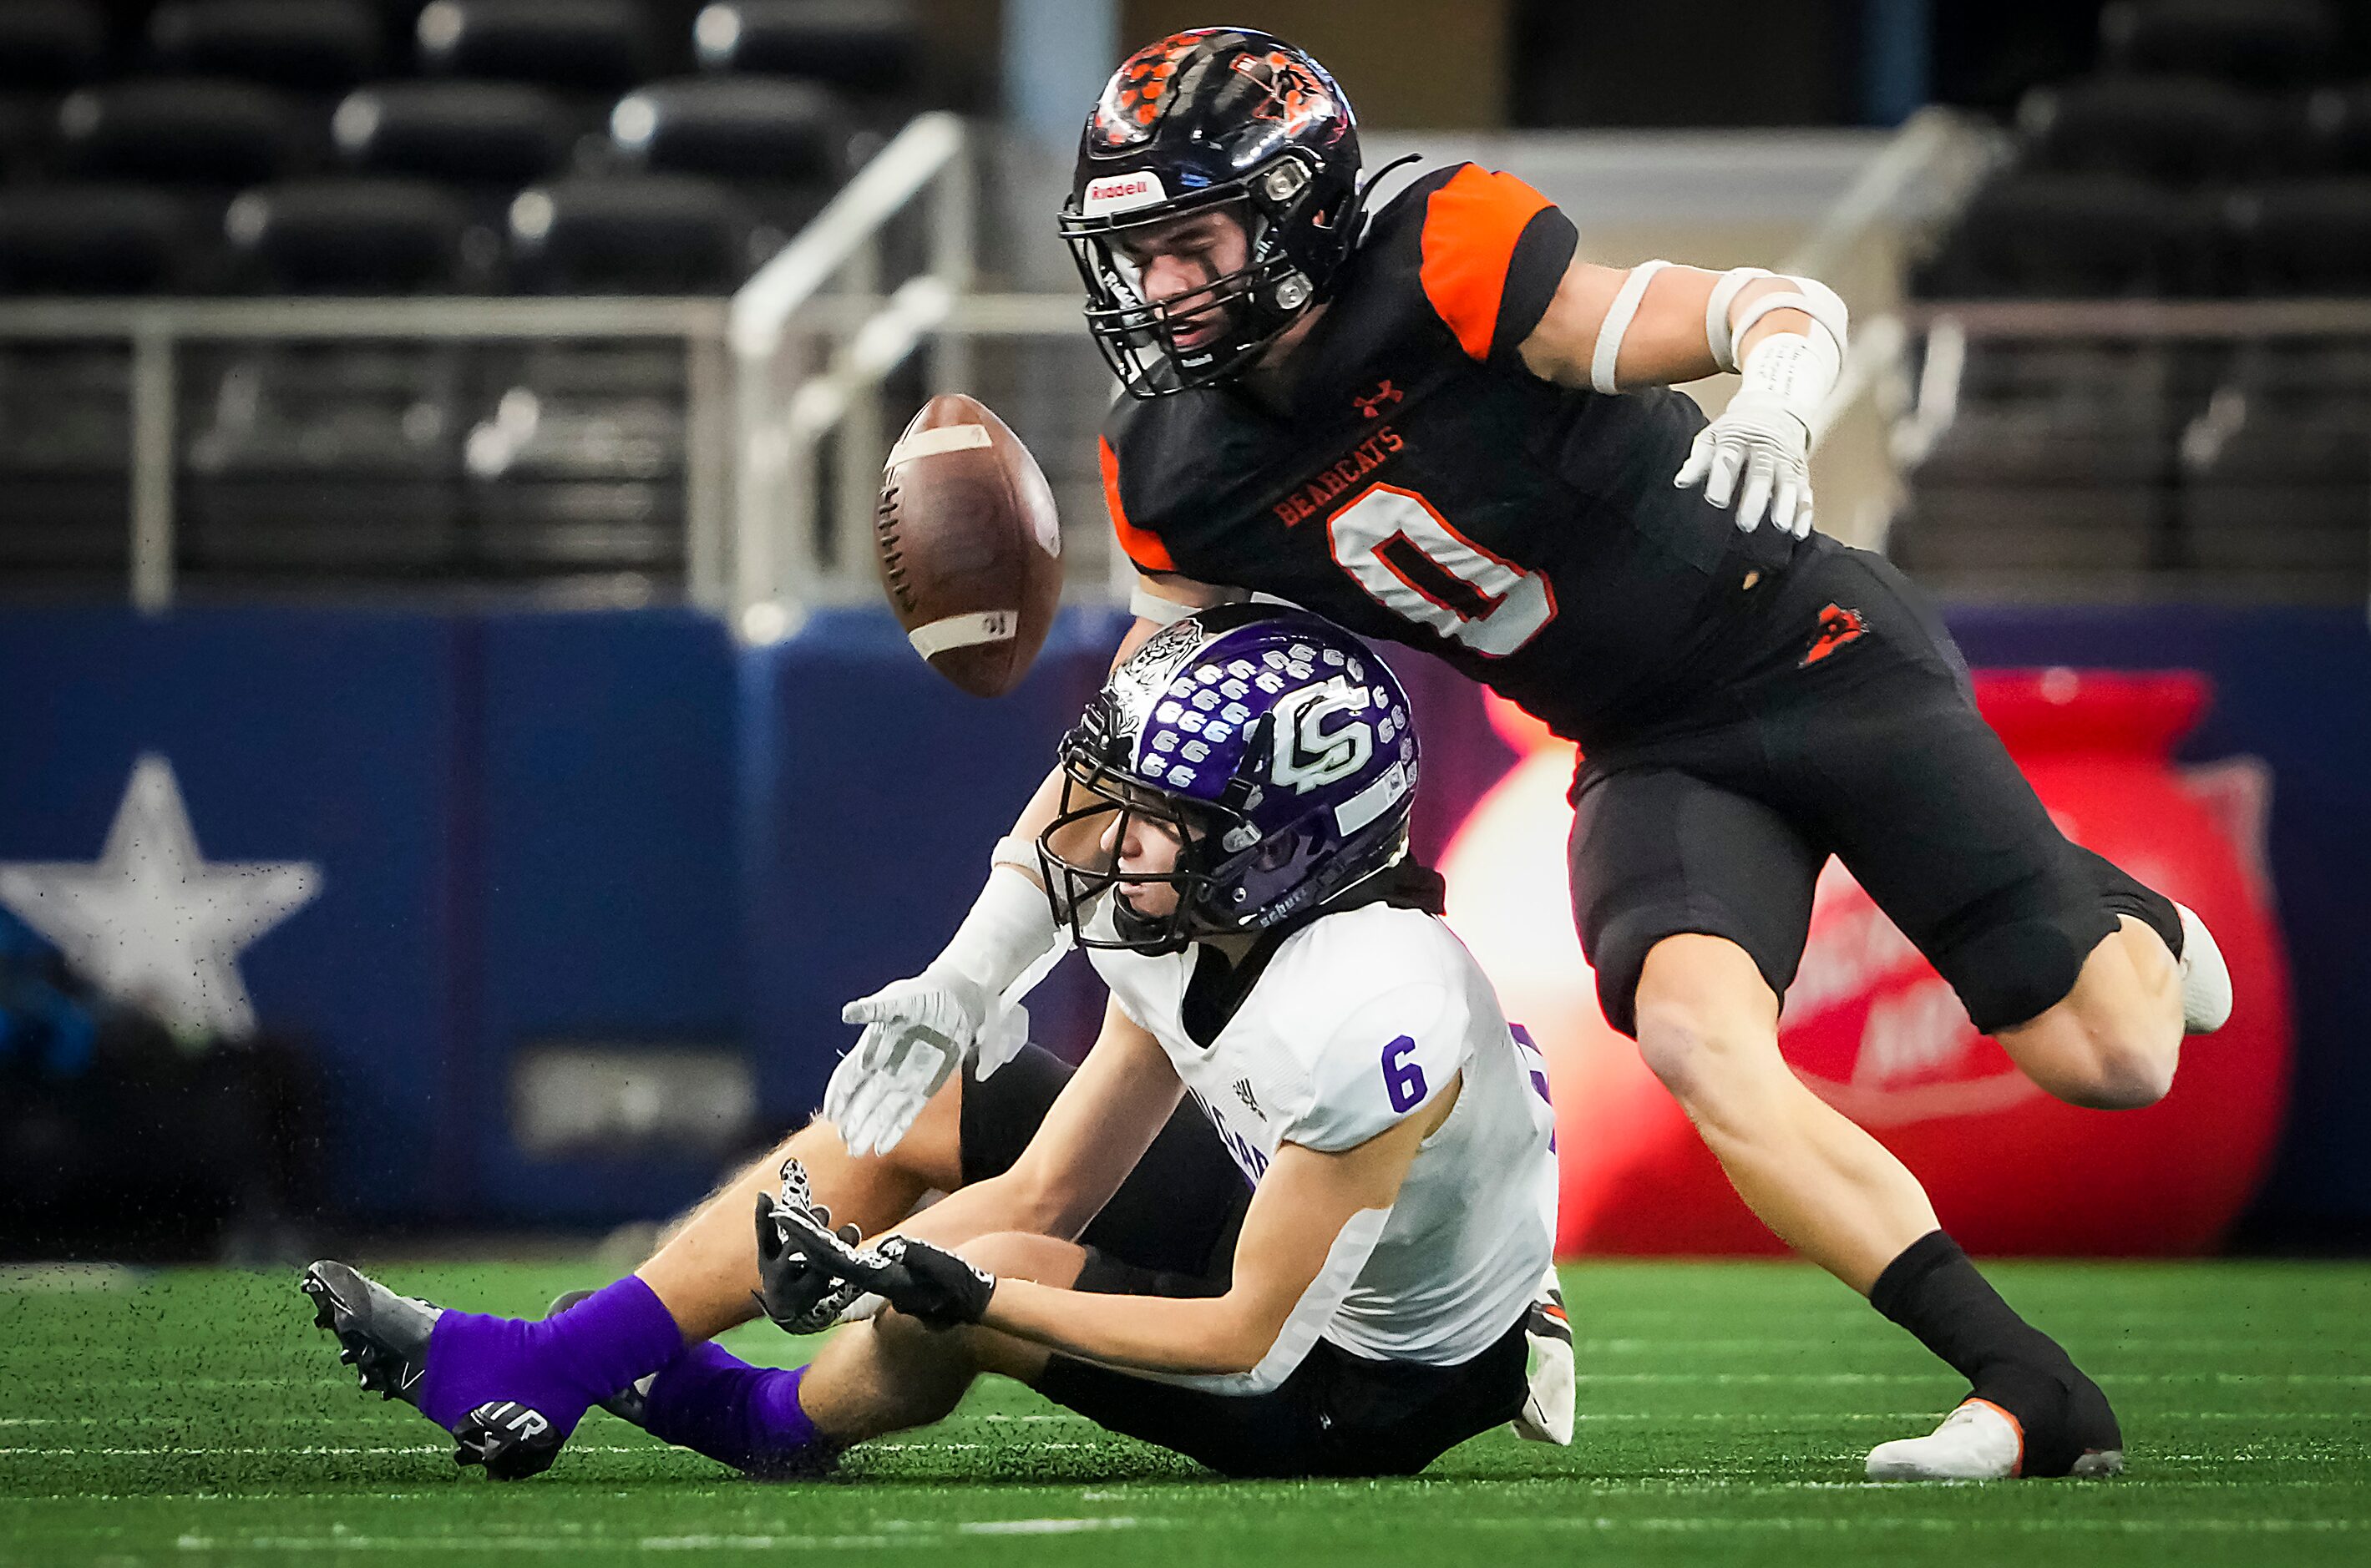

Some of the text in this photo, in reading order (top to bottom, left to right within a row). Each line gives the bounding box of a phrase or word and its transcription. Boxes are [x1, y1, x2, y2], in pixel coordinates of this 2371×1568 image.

[1273, 426, 1404, 528] BEARCATS
[1326, 481, 1558, 659] 0
[1381, 1034, 1428, 1113] 6
